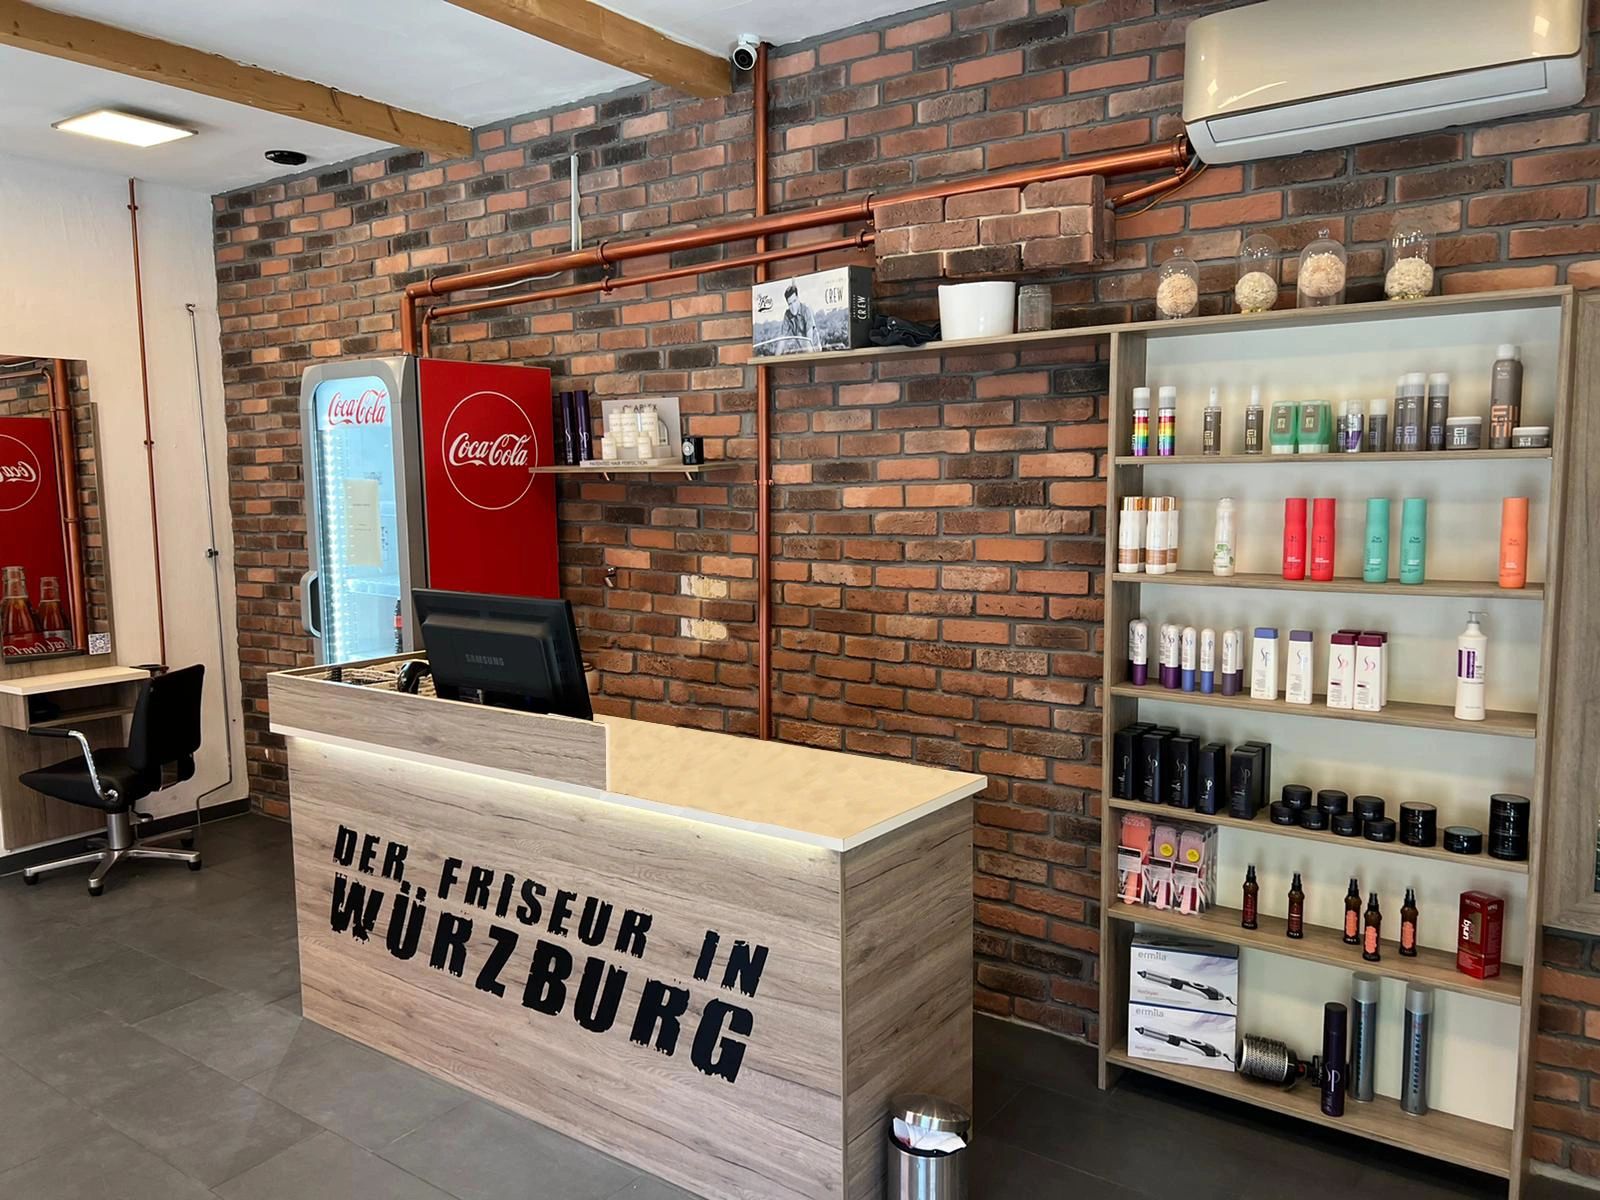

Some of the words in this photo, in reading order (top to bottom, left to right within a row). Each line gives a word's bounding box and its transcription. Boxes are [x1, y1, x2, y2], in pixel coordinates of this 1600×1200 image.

[824, 286, 844, 305] CREW
[857, 295, 867, 321] CREW
[327, 389, 389, 426] Coca-Cola
[448, 431, 532, 468] Coca-Cola
[464, 653, 505, 667] SAMSUNG
[332, 824, 409, 883] DER
[437, 856, 654, 959] FRISEUR
[692, 928, 770, 998] IN
[1137, 951, 1168, 962] ermila
[329, 871, 756, 1084] WÜRZBURG
[1135, 1007, 1165, 1018] ermila
